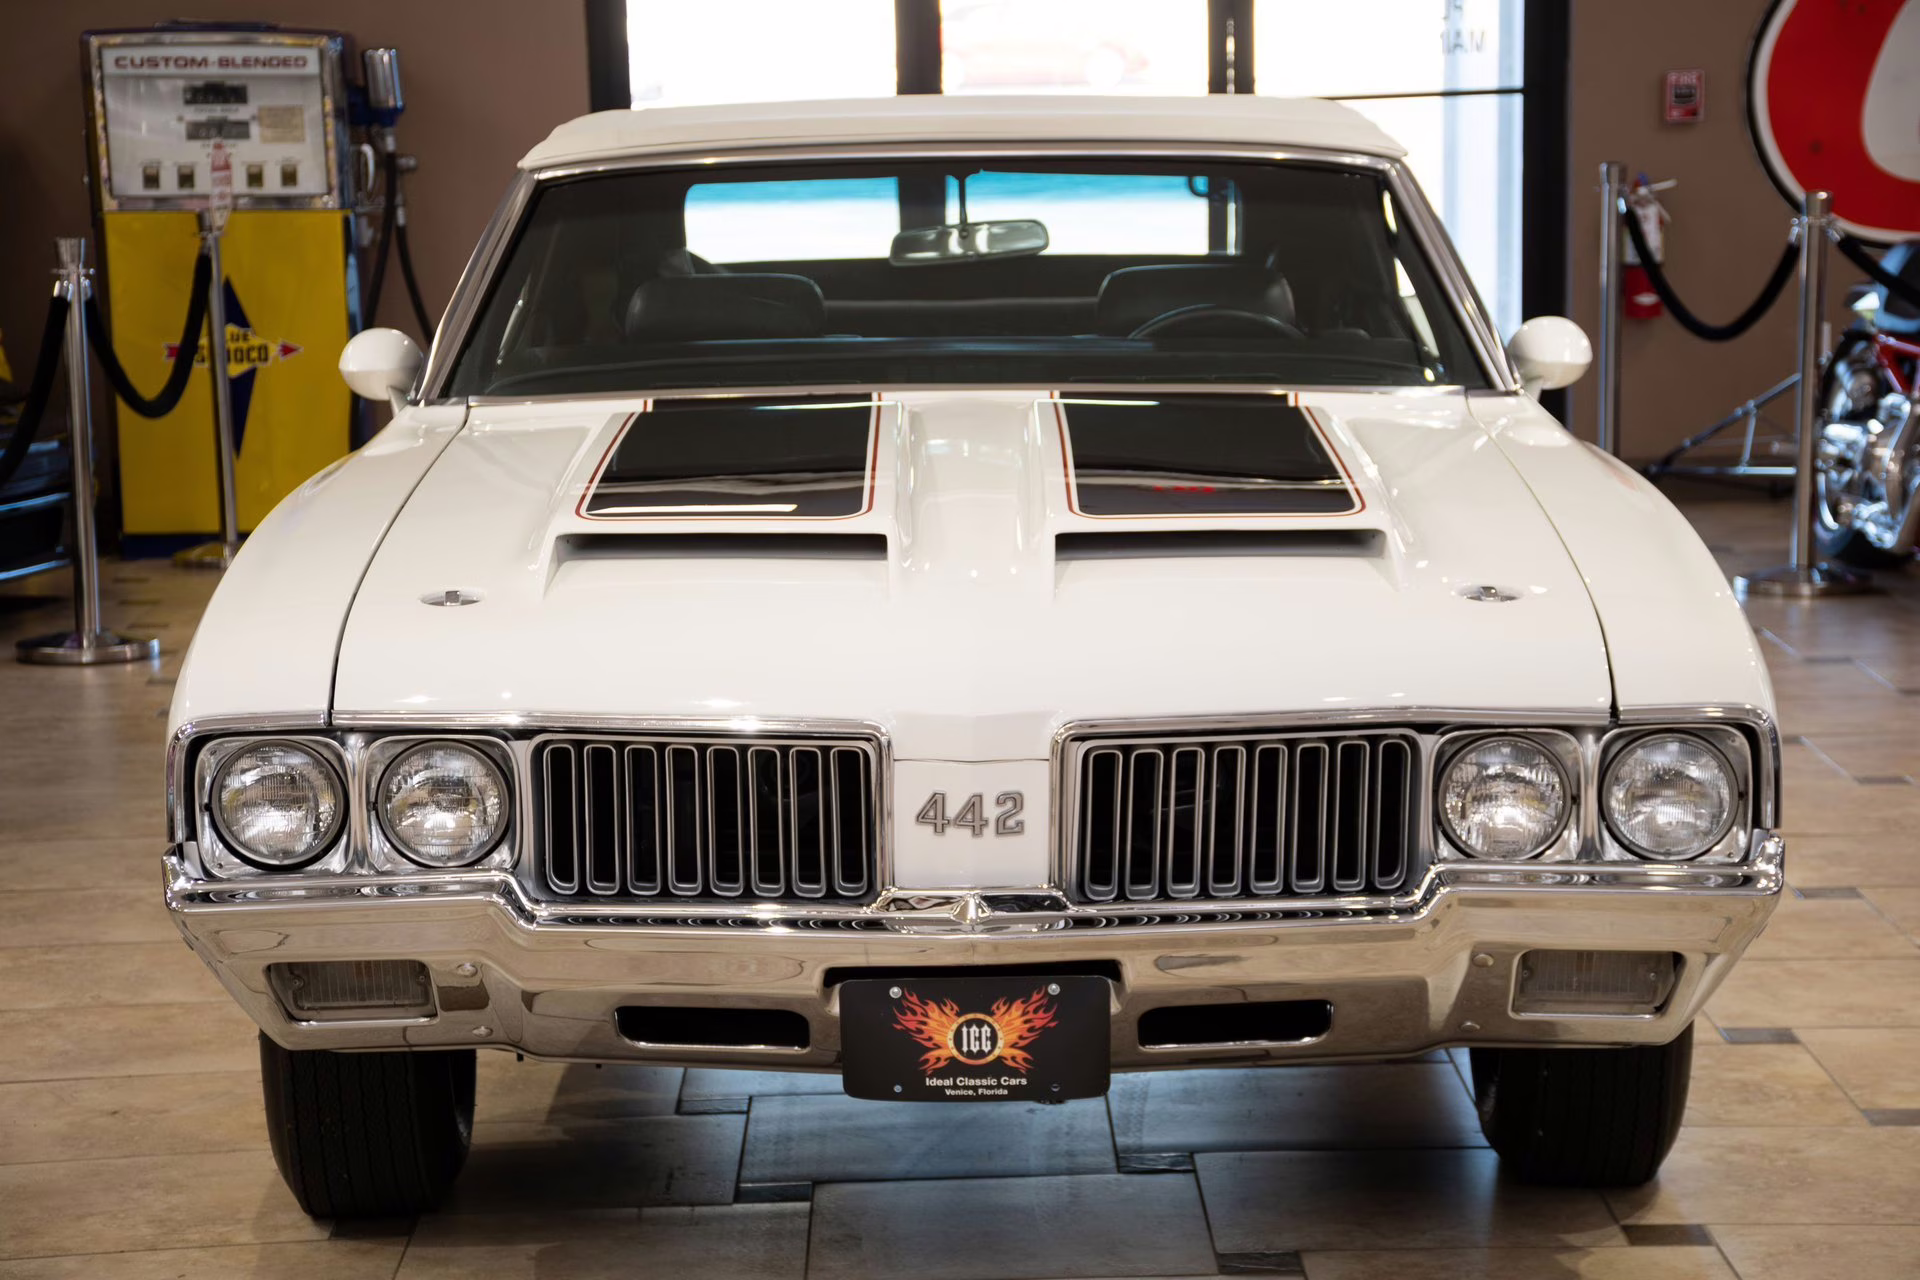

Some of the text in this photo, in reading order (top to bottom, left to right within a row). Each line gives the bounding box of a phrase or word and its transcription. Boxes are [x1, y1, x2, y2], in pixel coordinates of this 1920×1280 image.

[916, 791, 1024, 836] 442
[962, 1023, 991, 1054] ICC
[925, 1076, 1028, 1087] Ideal Classic Cars
[945, 1087, 1008, 1097] Venice, Florida
